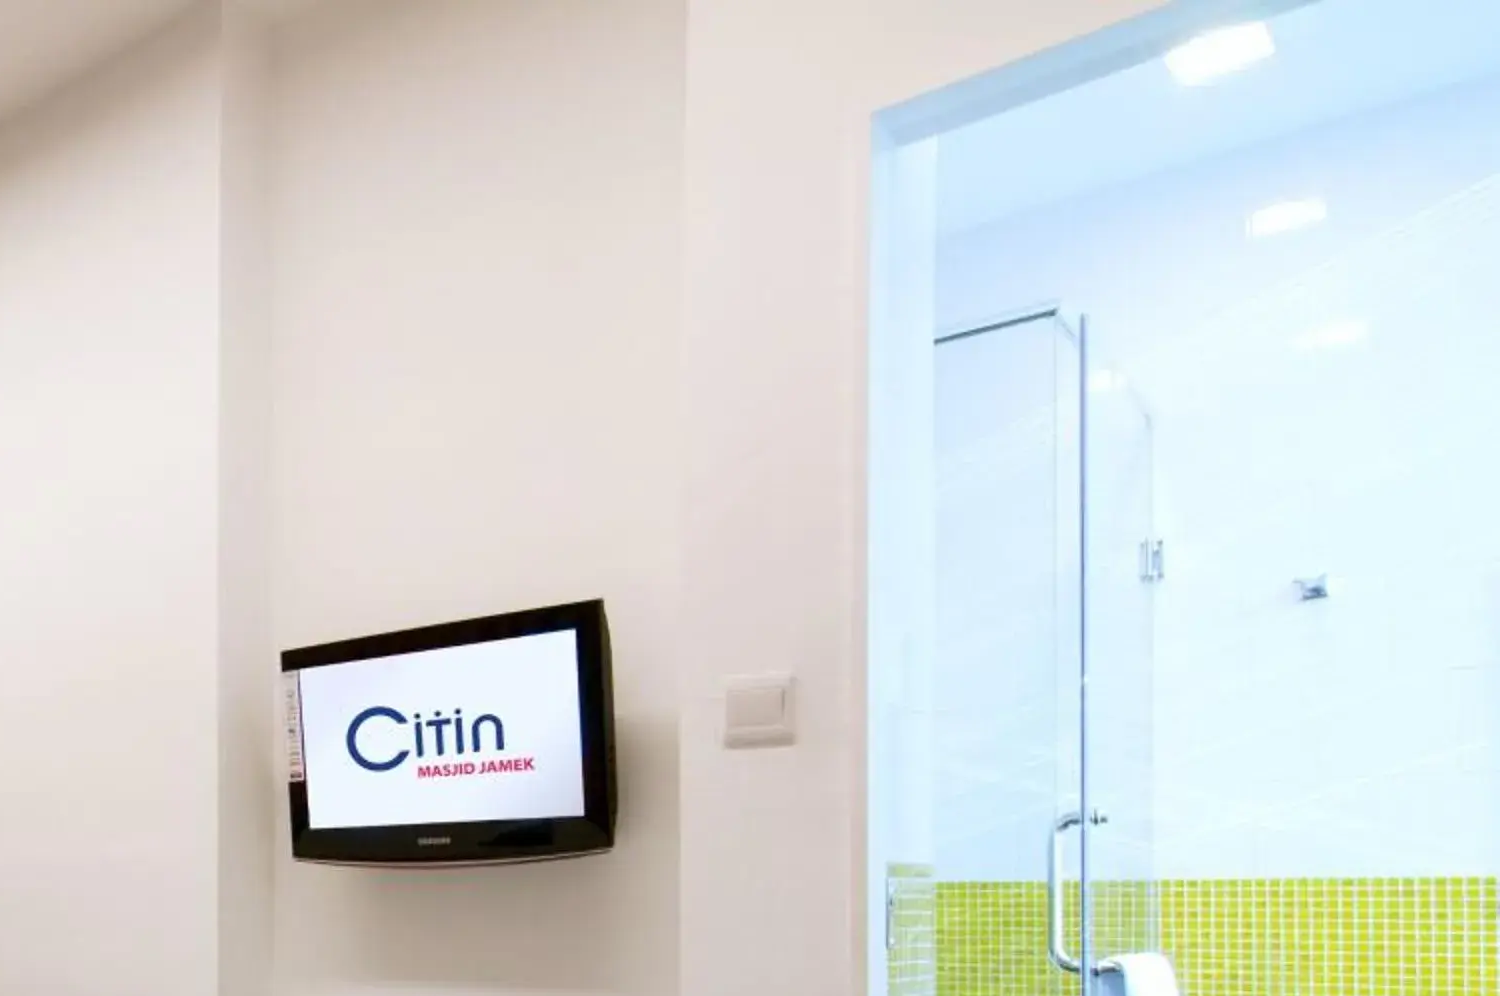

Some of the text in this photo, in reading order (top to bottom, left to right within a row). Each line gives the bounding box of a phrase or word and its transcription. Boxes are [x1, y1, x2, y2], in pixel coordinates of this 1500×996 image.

[346, 706, 504, 772] Citin
[417, 758, 535, 778] MASJID JAMEK
